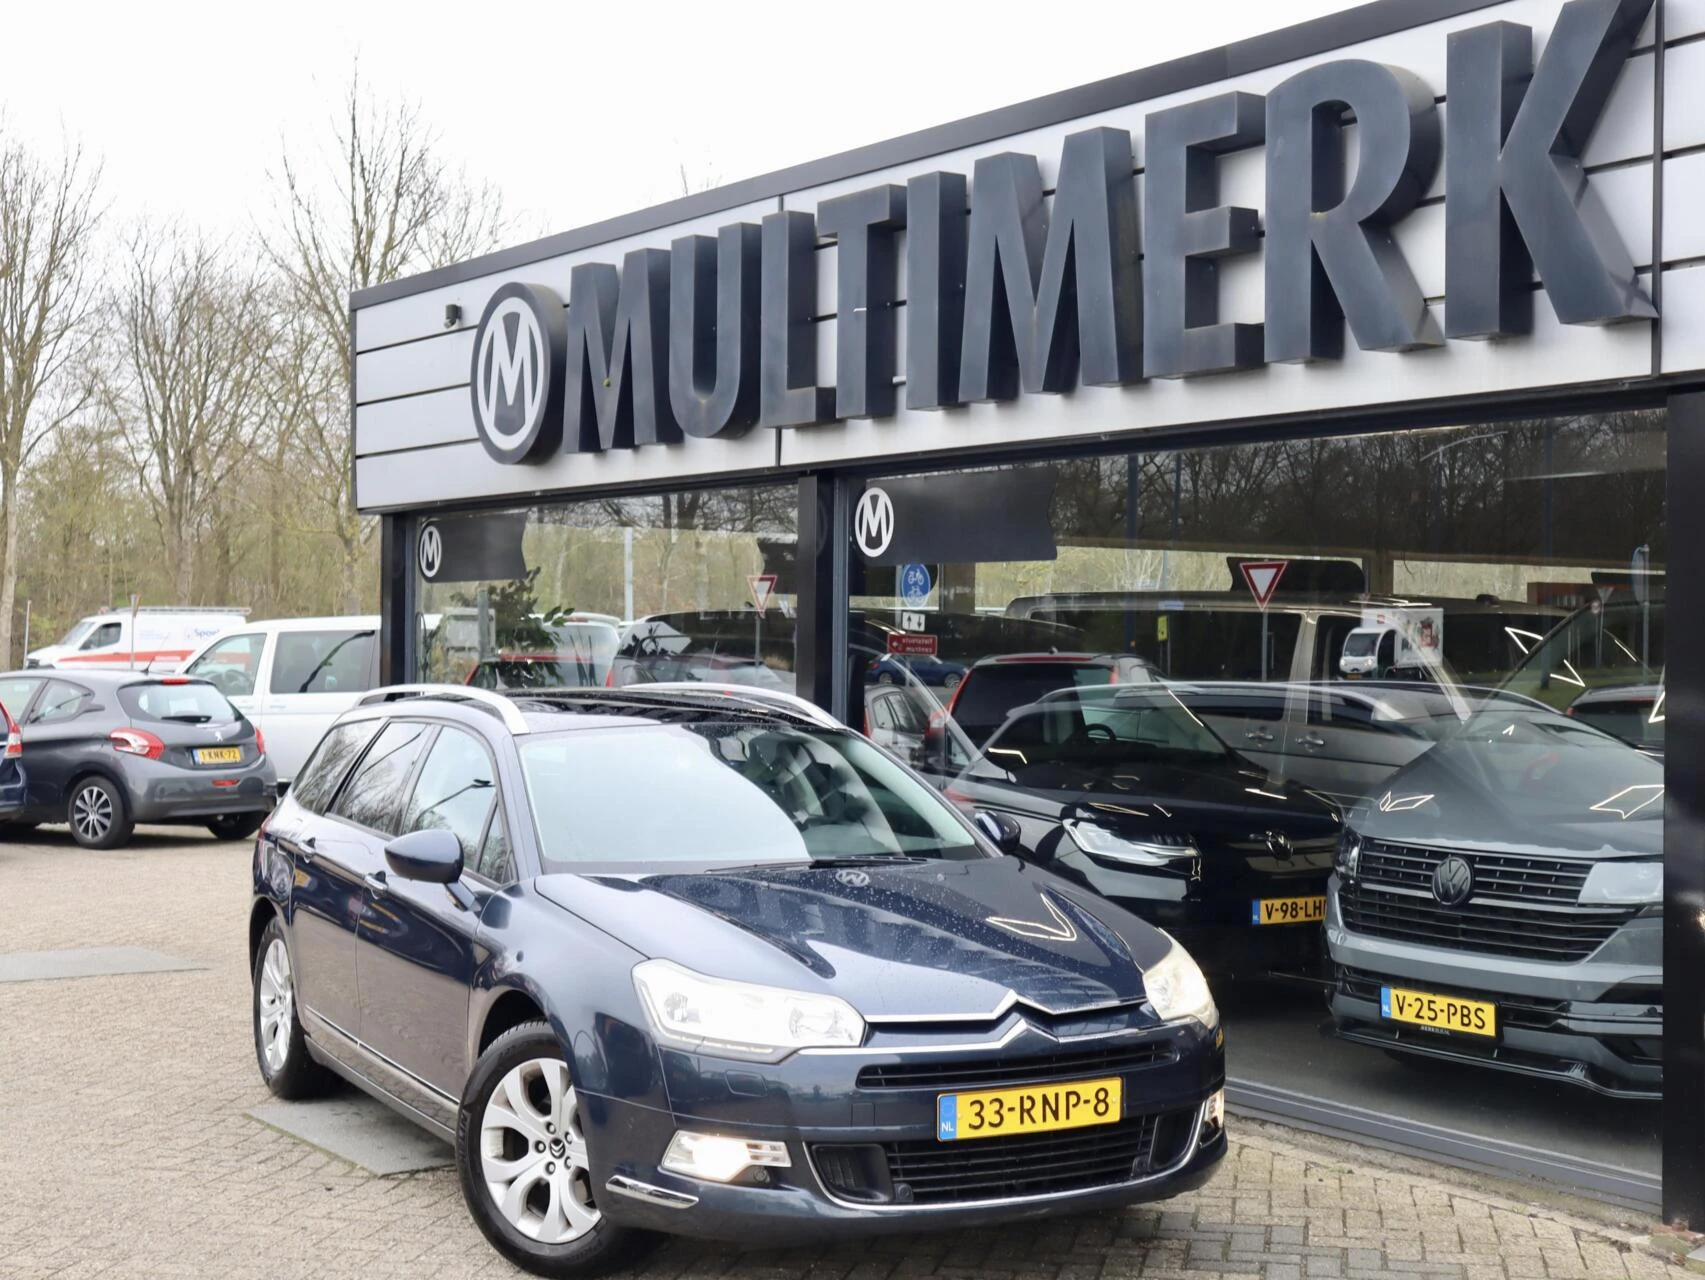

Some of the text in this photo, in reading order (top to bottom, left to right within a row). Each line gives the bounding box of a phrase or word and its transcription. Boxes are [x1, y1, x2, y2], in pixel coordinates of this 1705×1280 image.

[563, 0, 1659, 454] MULTIMERK
[1265, 899, 1327, 920] V-98-LH
[1395, 993, 1486, 1030] V-25-PBS
[941, 1087, 1110, 1132] NL 33-RNP-8
